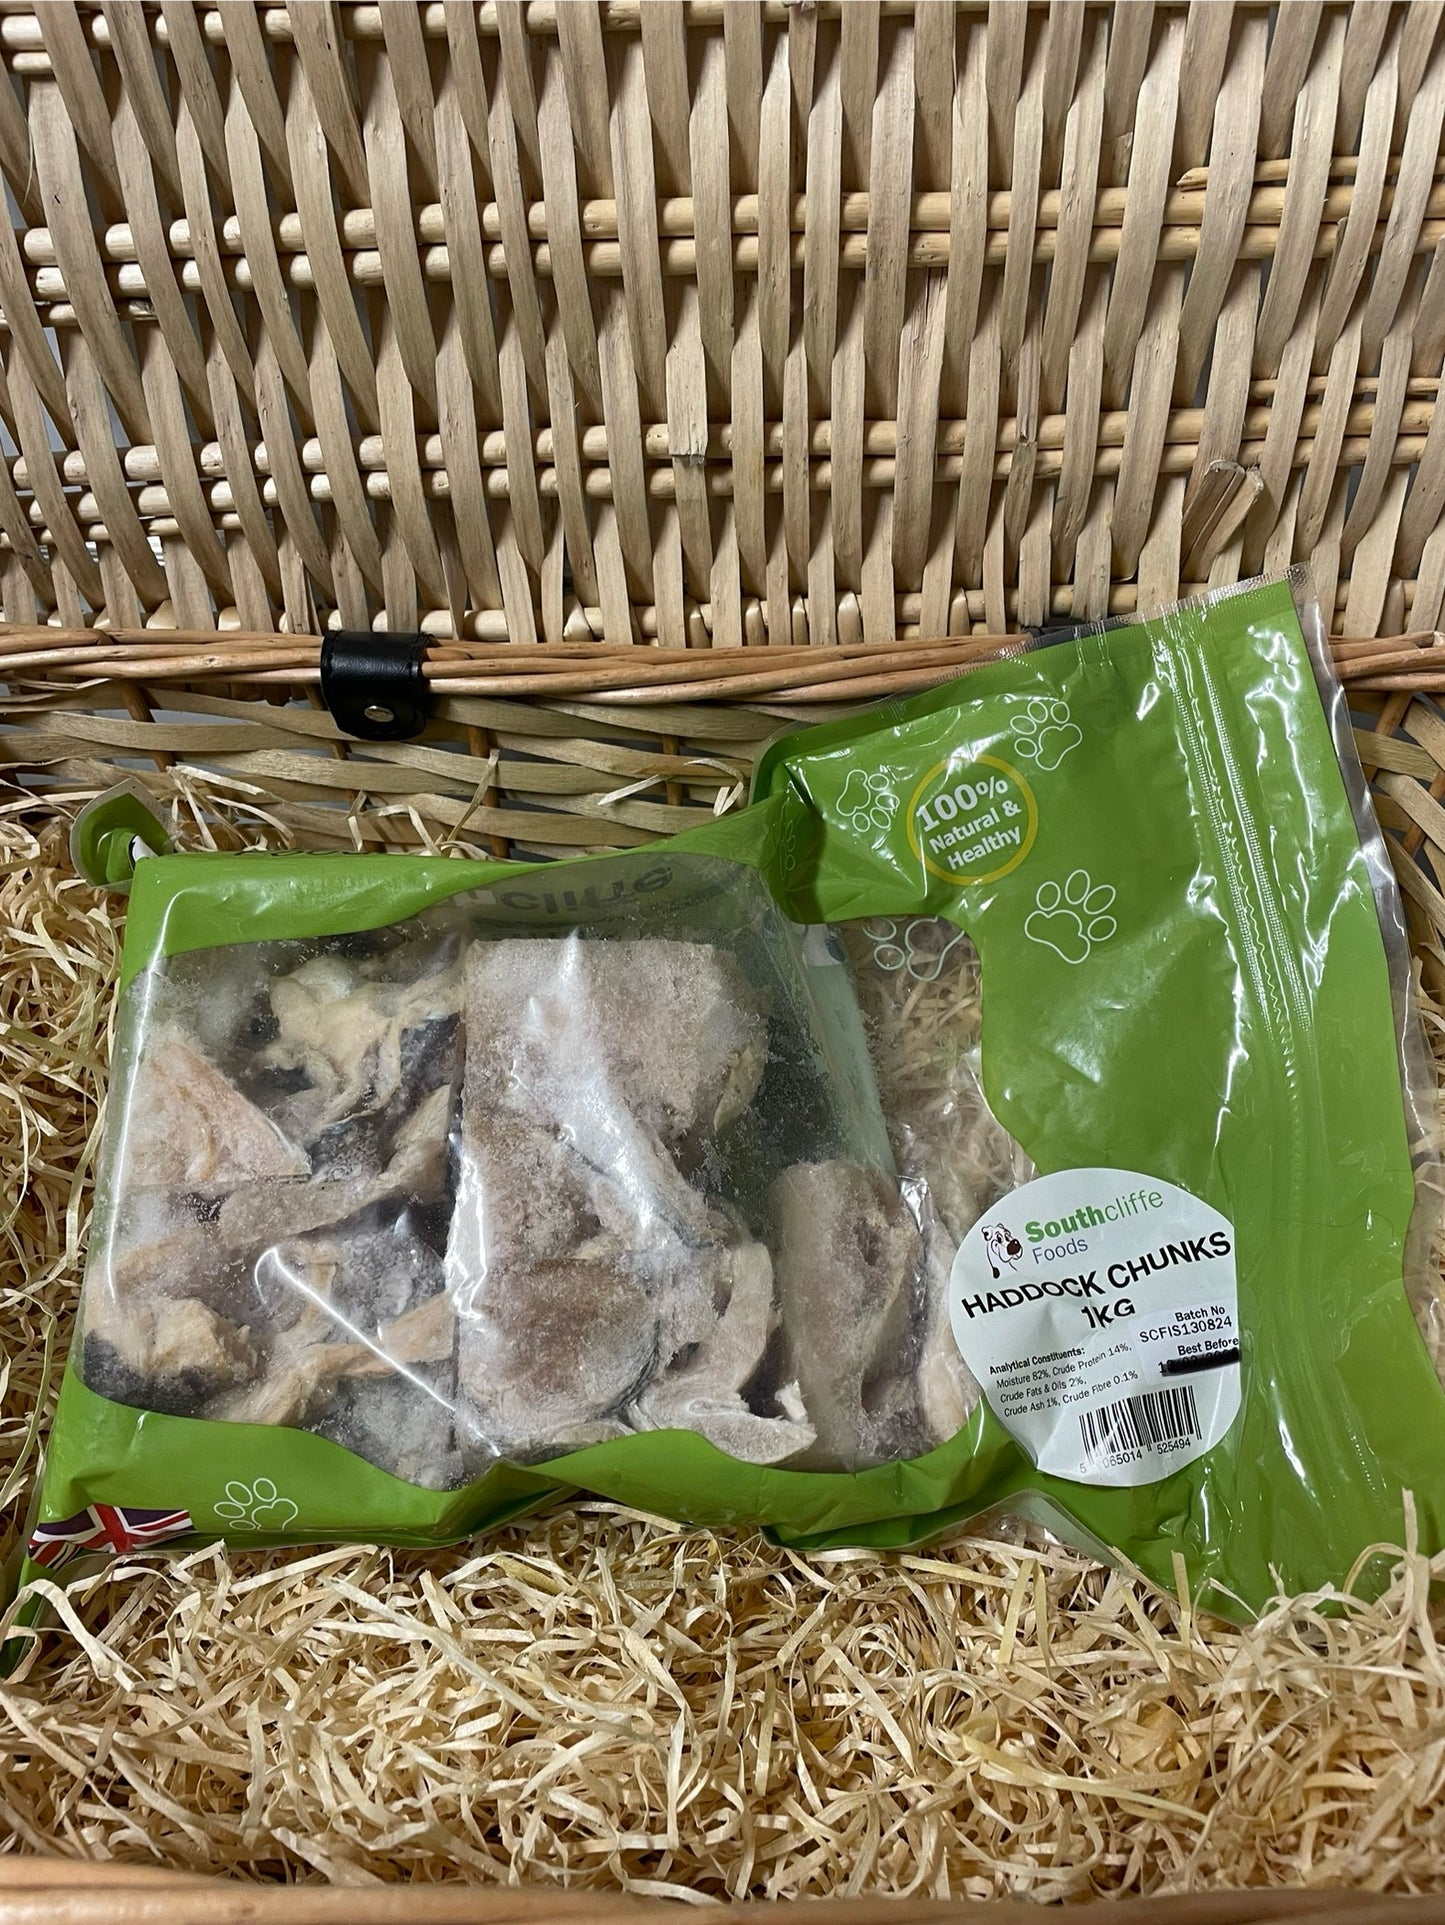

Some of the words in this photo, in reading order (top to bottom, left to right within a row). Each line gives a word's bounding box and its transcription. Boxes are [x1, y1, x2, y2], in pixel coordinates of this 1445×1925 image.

[916, 776, 1008, 832] 100%
[929, 808, 1000, 854] Natural
[1002, 800, 1022, 817] &
[948, 826, 1021, 870] Healthy
[1025, 1190, 1163, 1243] Southcliffe
[1032, 1238, 1088, 1264] Foods
[961, 1271, 1106, 1318] HADDOCK
[1107, 1231, 1232, 1288] CHUNKS
[1081, 1299, 1136, 1329] 1KG
[1140, 1316, 1232, 1342] SCFIS130824
[1175, 1308, 1208, 1322] Batch
[1211, 1306, 1225, 1316] No
[989, 1357, 1030, 1376] Analytical
[1032, 1347, 1085, 1366] Constituents:
[1177, 1342, 1202, 1356] Best
[1205, 1337, 1239, 1351] Before
[996, 1373, 1031, 1389] Moisture
[1032, 1369, 1051, 1381] 82%,
[1052, 1364, 1076, 1376] Crude
[1078, 1352, 1106, 1370] Protein
[1108, 1343, 1132, 1357] 14%,
[1000, 1391, 1024, 1404] Crude
[1027, 1387, 1042, 1397] Fats
[1044, 1383, 1050, 1393] &
[1052, 1380, 1067, 1391] Oils
[1004, 1405, 1027, 1418] Crude
[1030, 1402, 1045, 1412] Ash
[1063, 1391, 1089, 1404] Crude
[1092, 1380, 1112, 1394] Fibre
[1113, 1370, 1139, 1385] 0.1%
[1103, 1449, 1143, 1468] 065014
[1157, 1437, 1191, 1455] 525494
